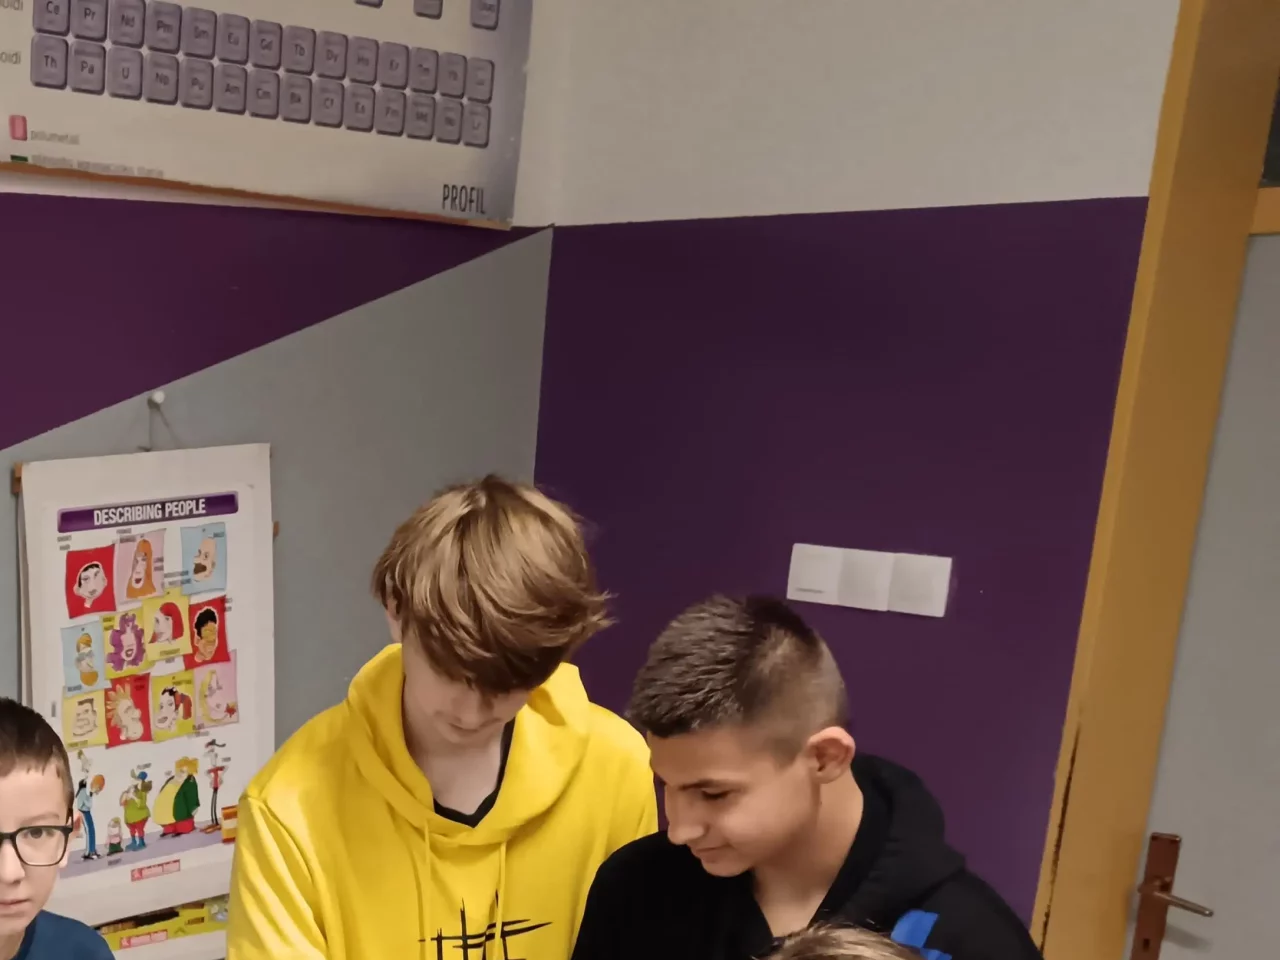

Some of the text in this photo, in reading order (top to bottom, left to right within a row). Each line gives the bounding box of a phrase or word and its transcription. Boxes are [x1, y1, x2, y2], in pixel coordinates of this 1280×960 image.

[46, 0, 61, 15] Ce
[84, 7, 96, 20] Pr
[43, 54, 58, 69] Th
[80, 60, 95, 74] Pa
[122, 66, 131, 79] U
[442, 184, 486, 215] PROFIL
[93, 497, 207, 526] DESCRIBING PEOPLE
